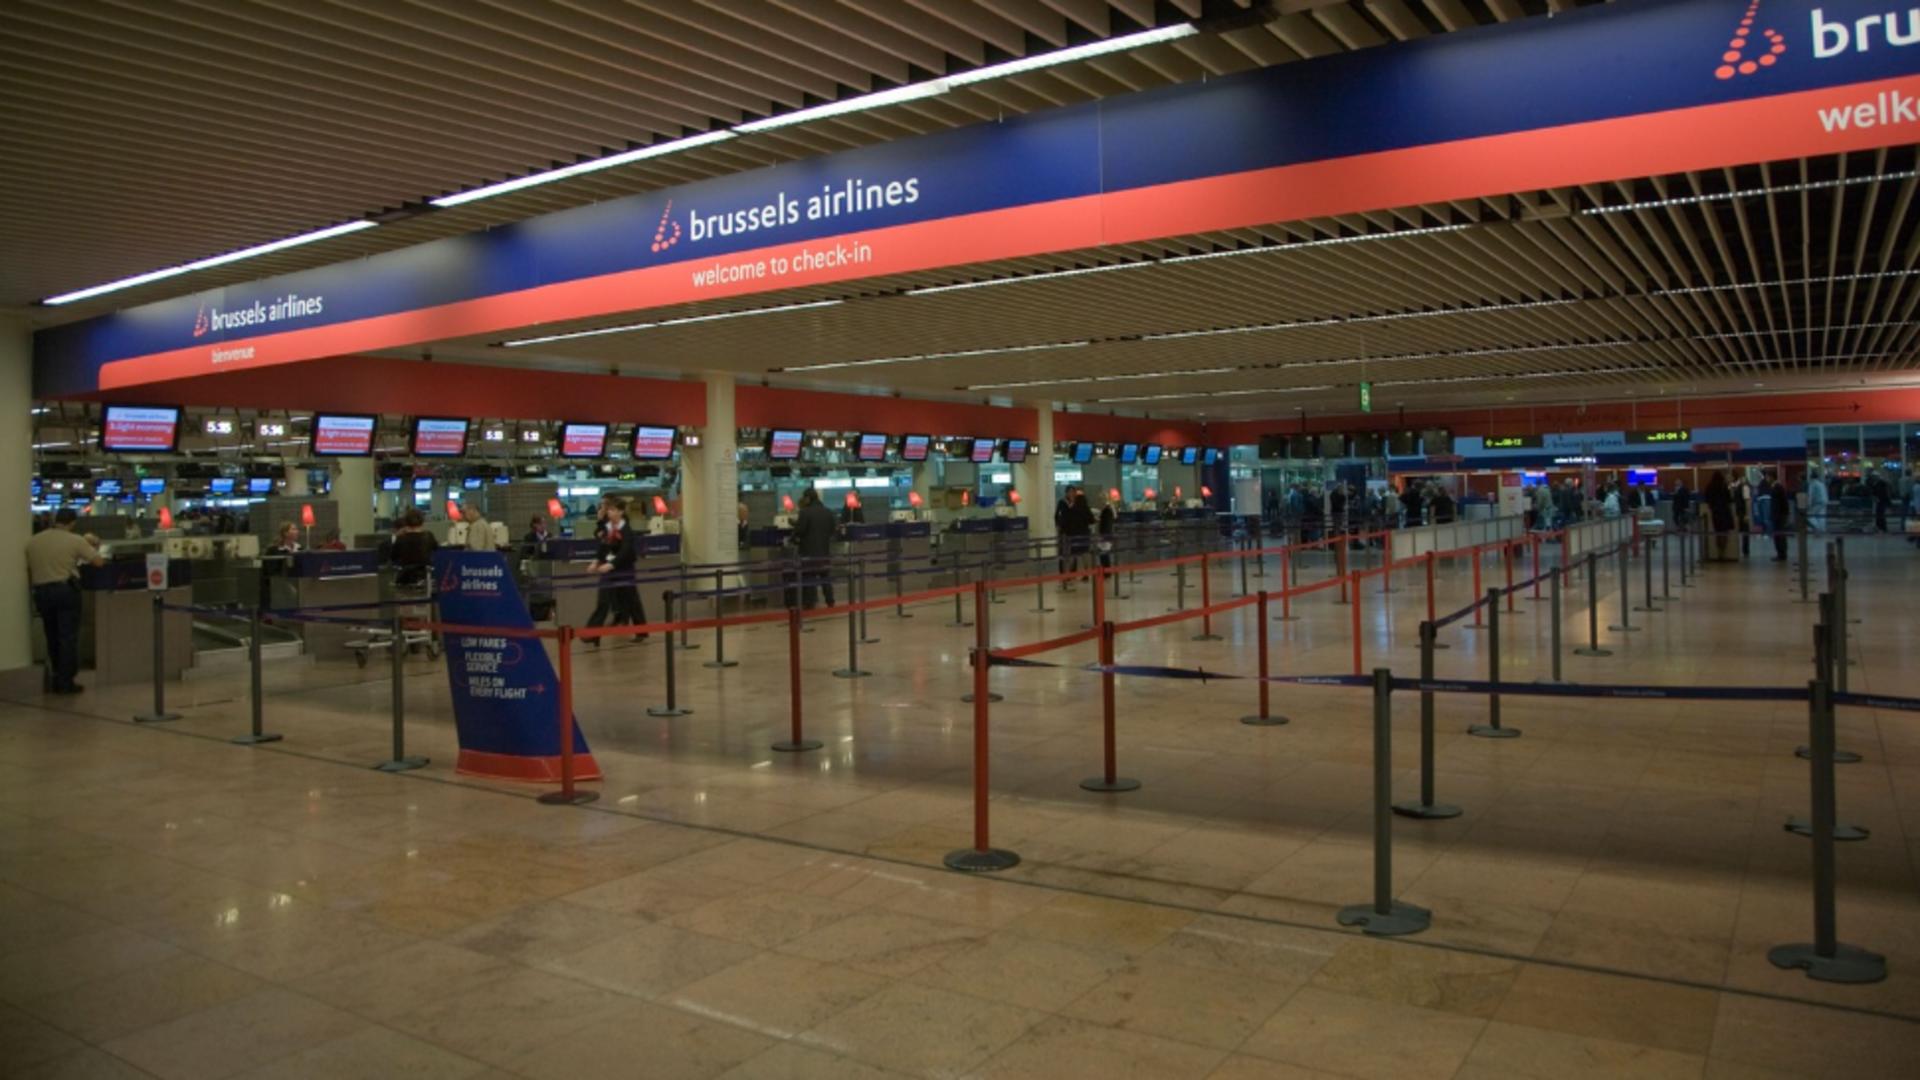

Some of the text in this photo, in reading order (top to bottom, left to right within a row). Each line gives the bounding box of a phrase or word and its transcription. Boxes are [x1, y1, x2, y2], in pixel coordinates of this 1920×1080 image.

[1818, 90, 1920, 132] welk
[690, 177, 920, 241] brussels airlines
[692, 241, 871, 287] welcome to check-in
[211, 294, 323, 331] brussels airlines
[211, 346, 255, 364] bienvenue
[461, 565, 503, 577] brussels
[461, 579, 498, 591] airlines
[461, 637, 507, 649] LOW FARES
[465, 651, 503, 663] FLEXIBLE
[466, 662, 498, 673] SERVICE
[494, 687, 528, 699] FLIGHT
